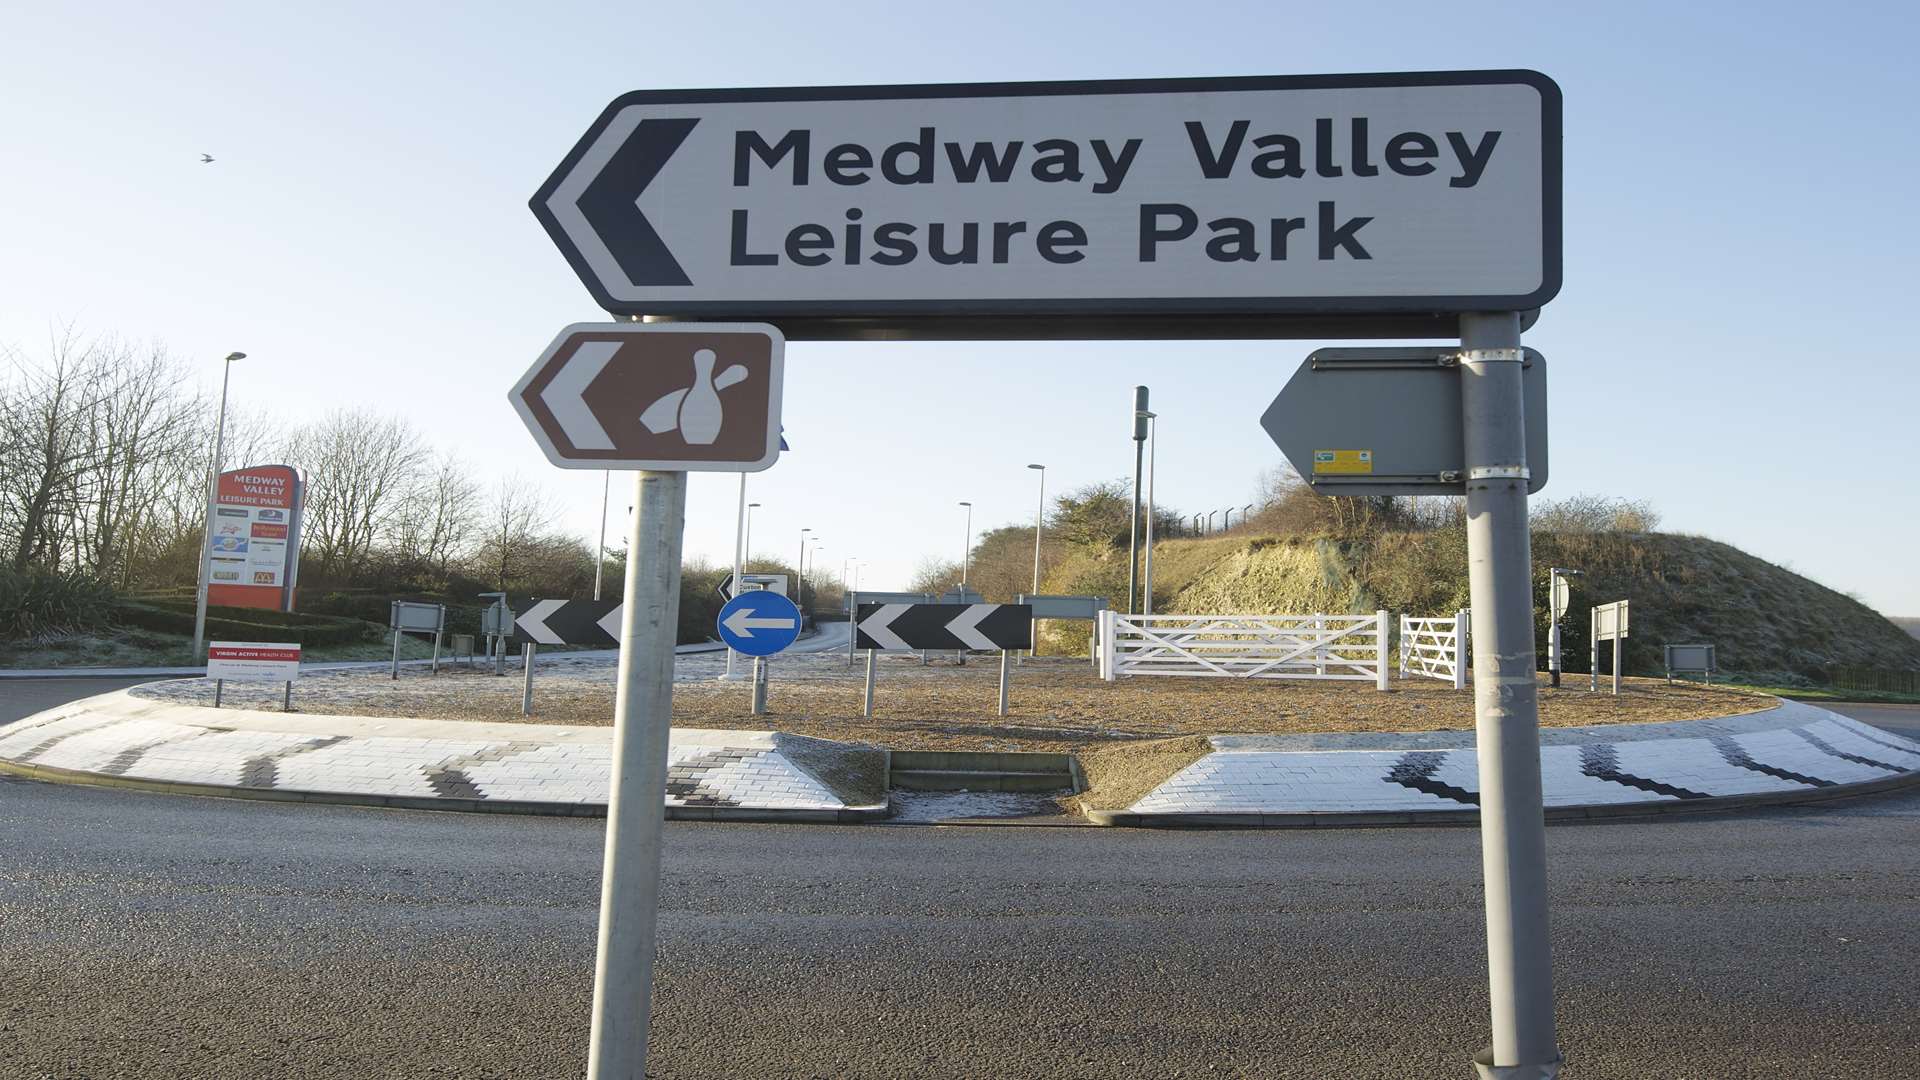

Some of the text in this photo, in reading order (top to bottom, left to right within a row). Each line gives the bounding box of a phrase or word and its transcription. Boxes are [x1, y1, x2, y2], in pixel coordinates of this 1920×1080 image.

[734, 117, 1502, 194] Medway Valley
[730, 201, 1374, 267] Leisure Park
[234, 474, 285, 486] MEDWAY
[243, 485, 285, 495] VALLEY
[220, 495, 284, 506] LEISURE PARK
